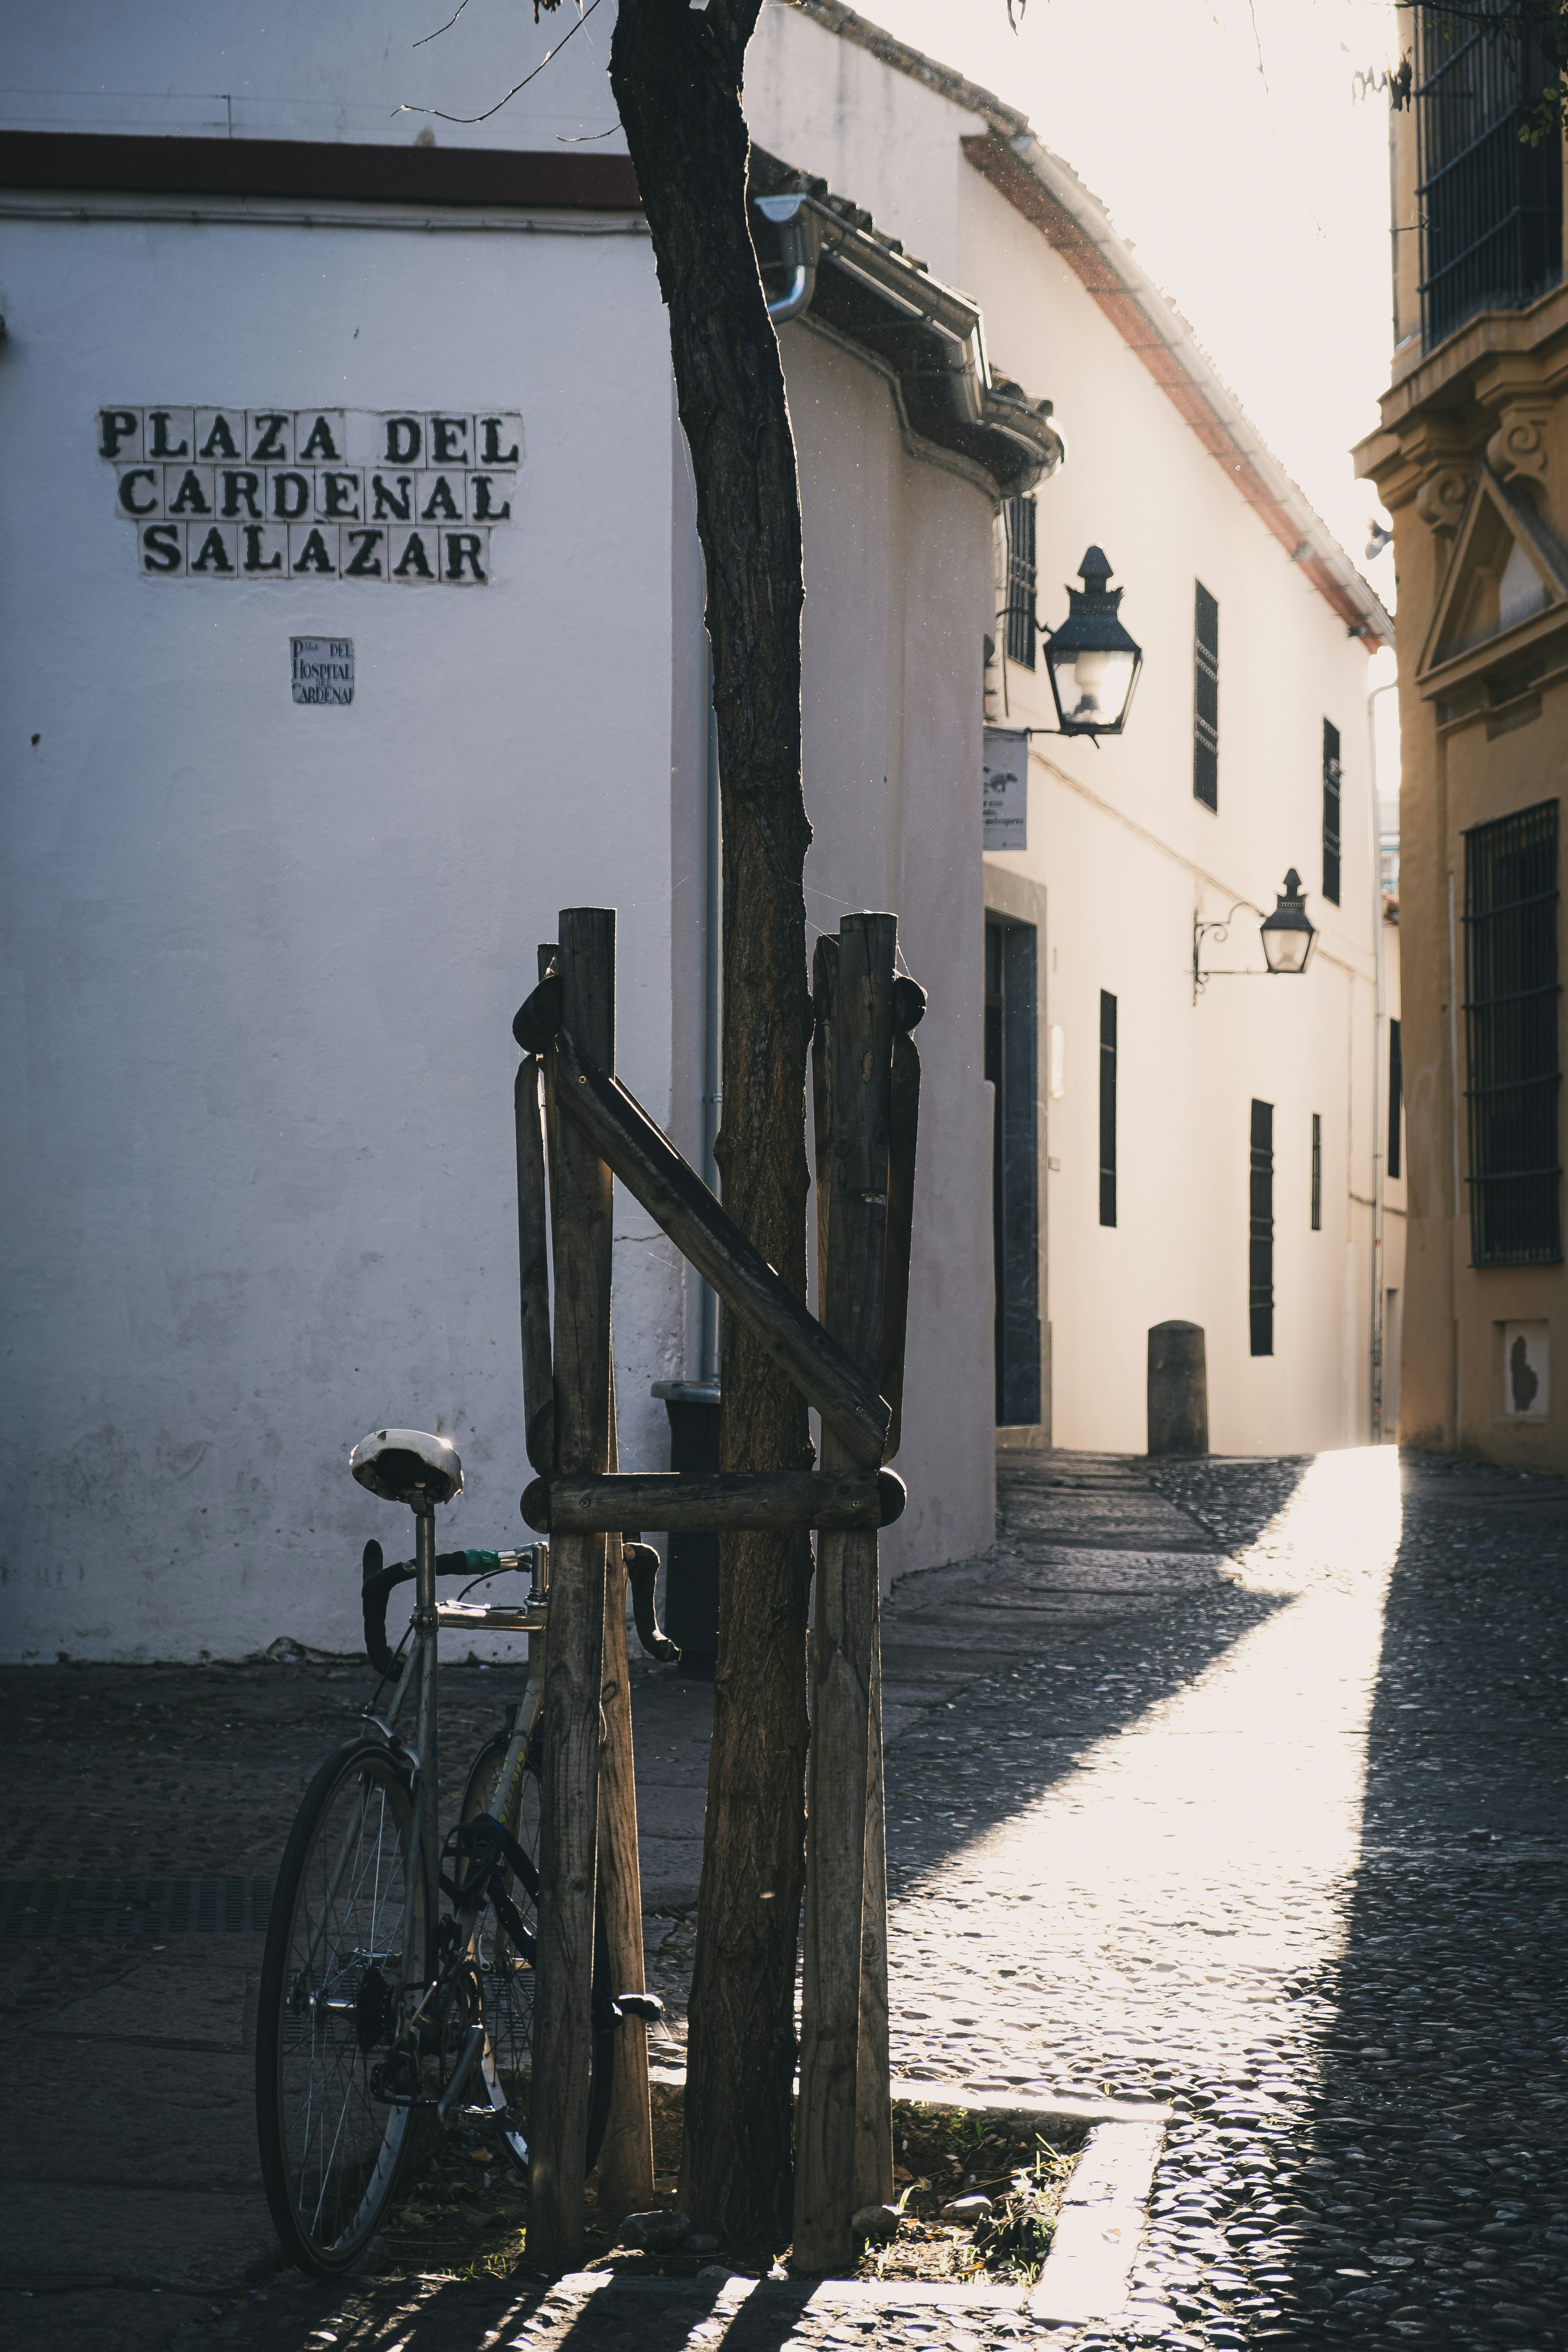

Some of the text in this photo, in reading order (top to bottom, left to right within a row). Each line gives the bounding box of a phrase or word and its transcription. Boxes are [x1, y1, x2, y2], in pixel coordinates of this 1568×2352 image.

[98, 409, 519, 464] PLAZA DEL
[118, 468, 510, 521] CARDENAL
[143, 523, 486, 580] SALAZAR
[293, 659, 353, 679] HOSPITAL
[330, 643, 351, 657] DEL
